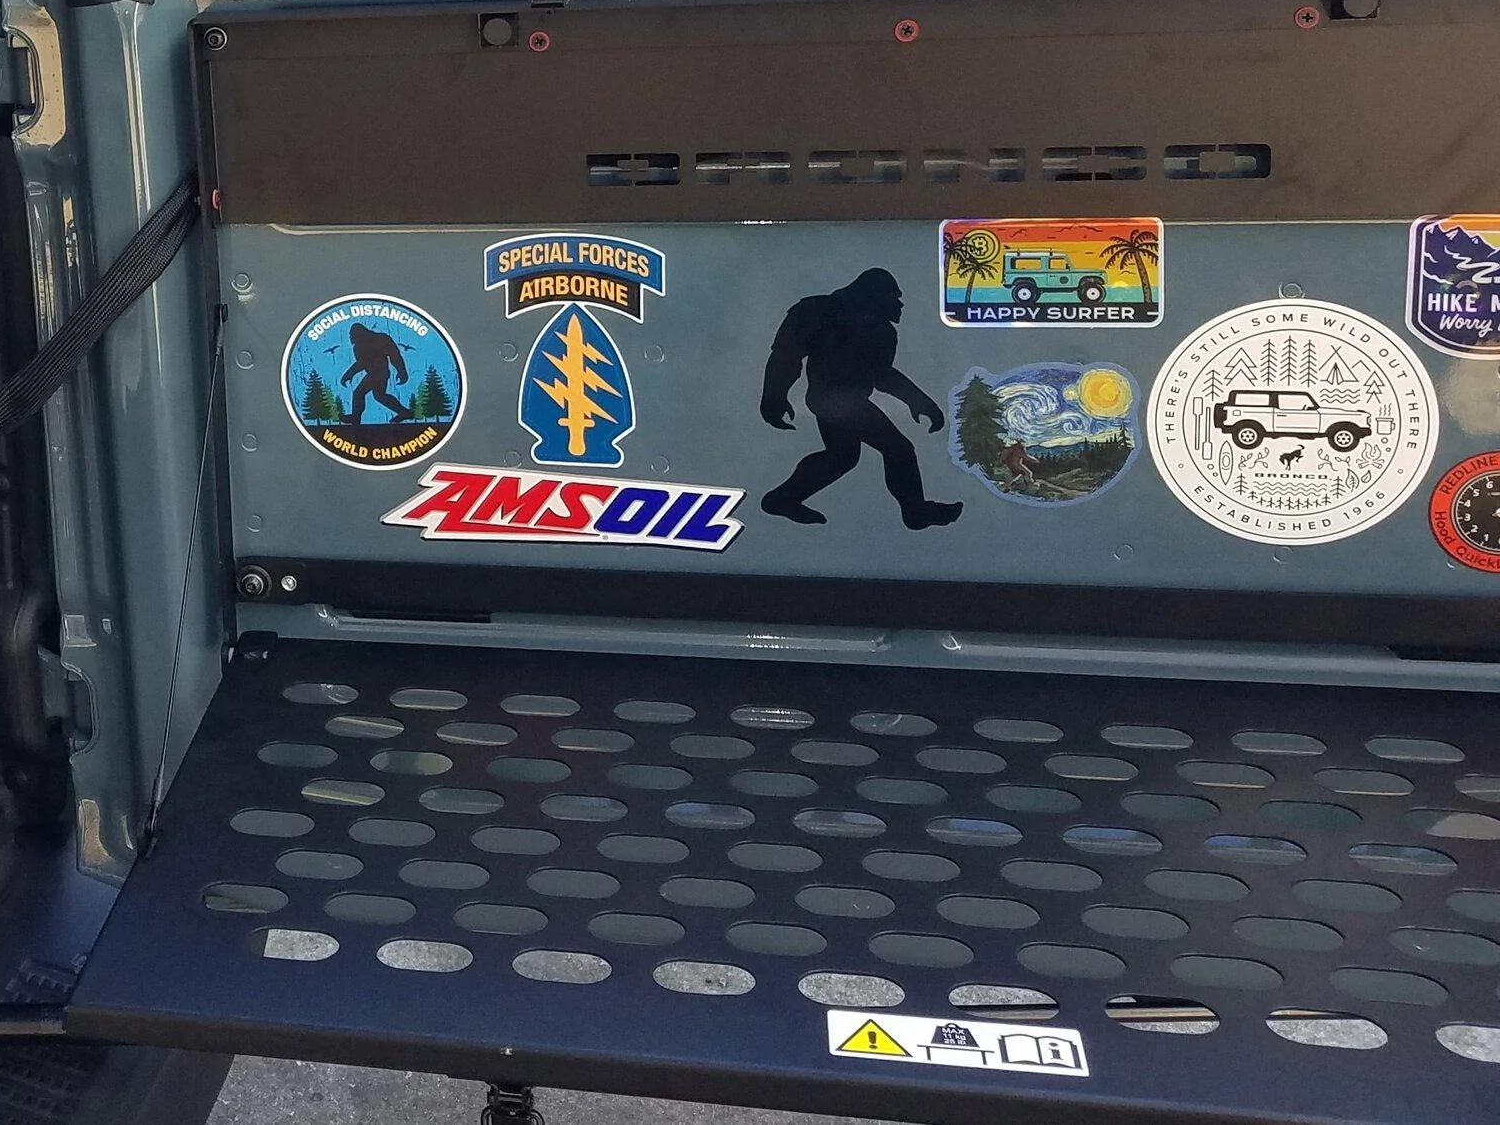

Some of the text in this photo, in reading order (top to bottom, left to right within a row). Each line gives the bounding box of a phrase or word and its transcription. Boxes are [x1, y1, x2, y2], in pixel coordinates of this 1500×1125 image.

[499, 242, 649, 277] SPECIAL FORCES
[519, 275, 628, 307] AIRBORNE
[1427, 293, 1478, 313] HIKE
[307, 304, 429, 341] SOCIAL DISTANCING
[967, 307, 1135, 320] HAPPY SURFER
[1439, 313, 1494, 338] Worry
[1165, 313, 1421, 450] THERE'S STILL SOME WILD OUT THERE
[322, 426, 438, 460] WORLD CHAMPION
[1440, 456, 1498, 494] REDLINE
[1486, 481, 1494, 489] 6
[1463, 499, 1471, 507] 4
[1472, 488, 1480, 497] 5
[401, 471, 732, 543] AMSOIL
[1194, 485, 1385, 532] ESTABLISHED 1966
[1464, 513, 1471, 522] 3
[1435, 511, 1457, 544] Hood
[1470, 525, 1478, 533] 2
[941, 1027, 965, 1035] MAX
